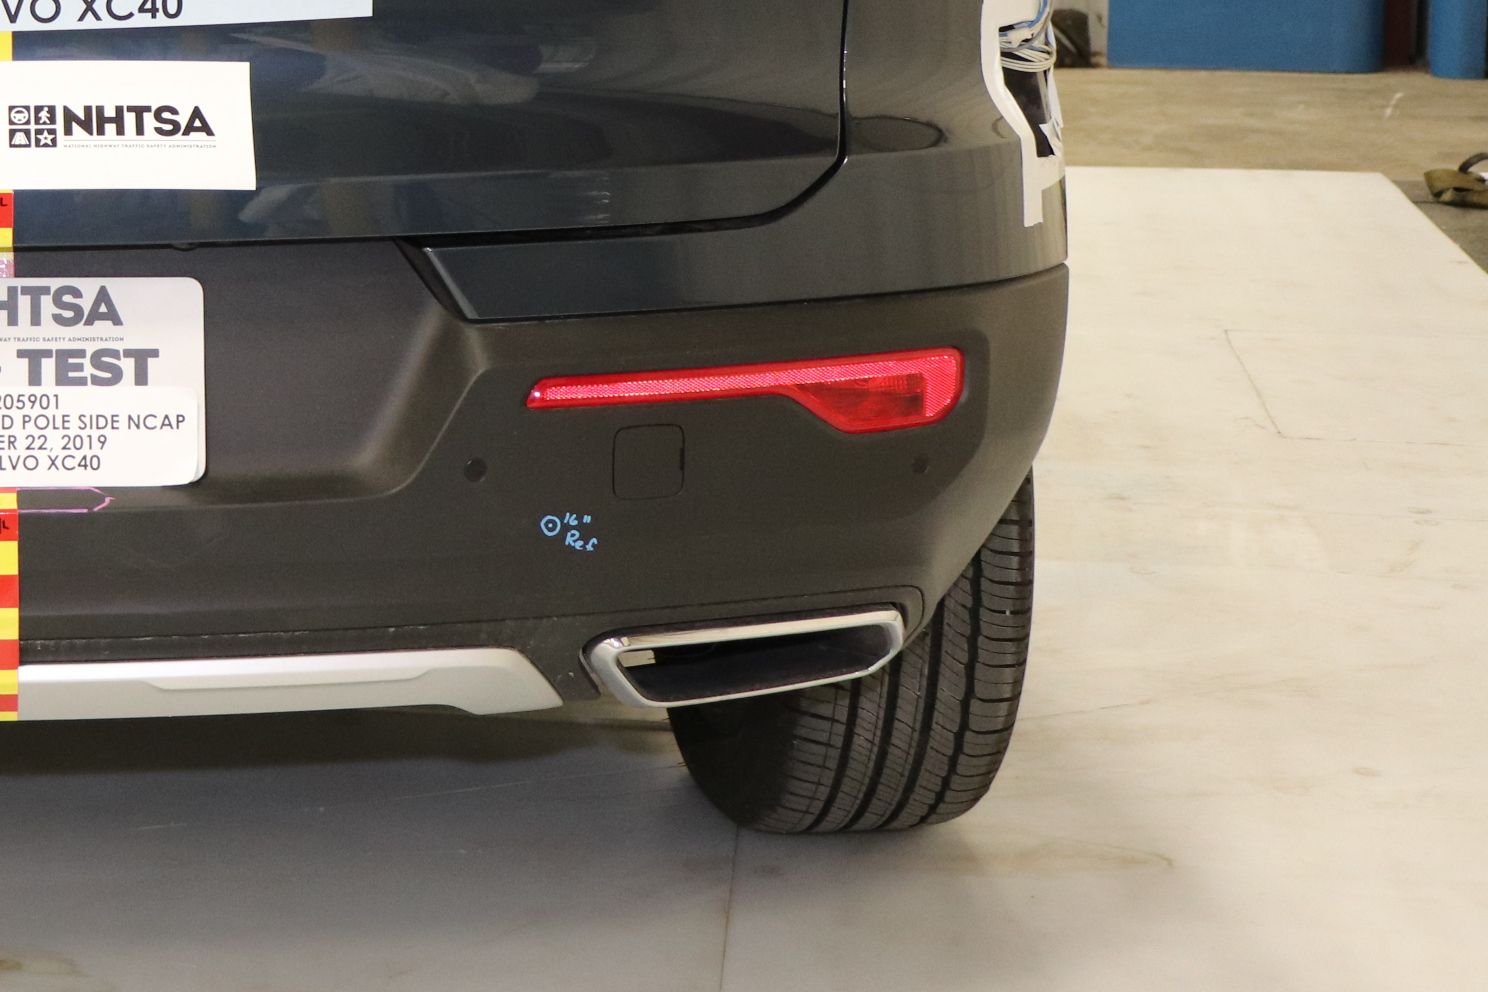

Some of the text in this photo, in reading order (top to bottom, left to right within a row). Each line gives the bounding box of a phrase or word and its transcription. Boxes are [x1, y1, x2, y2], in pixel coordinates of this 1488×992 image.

[62, 104, 215, 137] NHTSA
[16, 347, 160, 387] TEST
[22, 413, 71, 431] POLE
[78, 413, 120, 431] SIDE
[127, 413, 186, 431] NCAP
[25, 434, 53, 452] 22,
[61, 434, 108, 451] 2019
[47, 454, 101, 471] XC40
[564, 529, 598, 552] Ref
